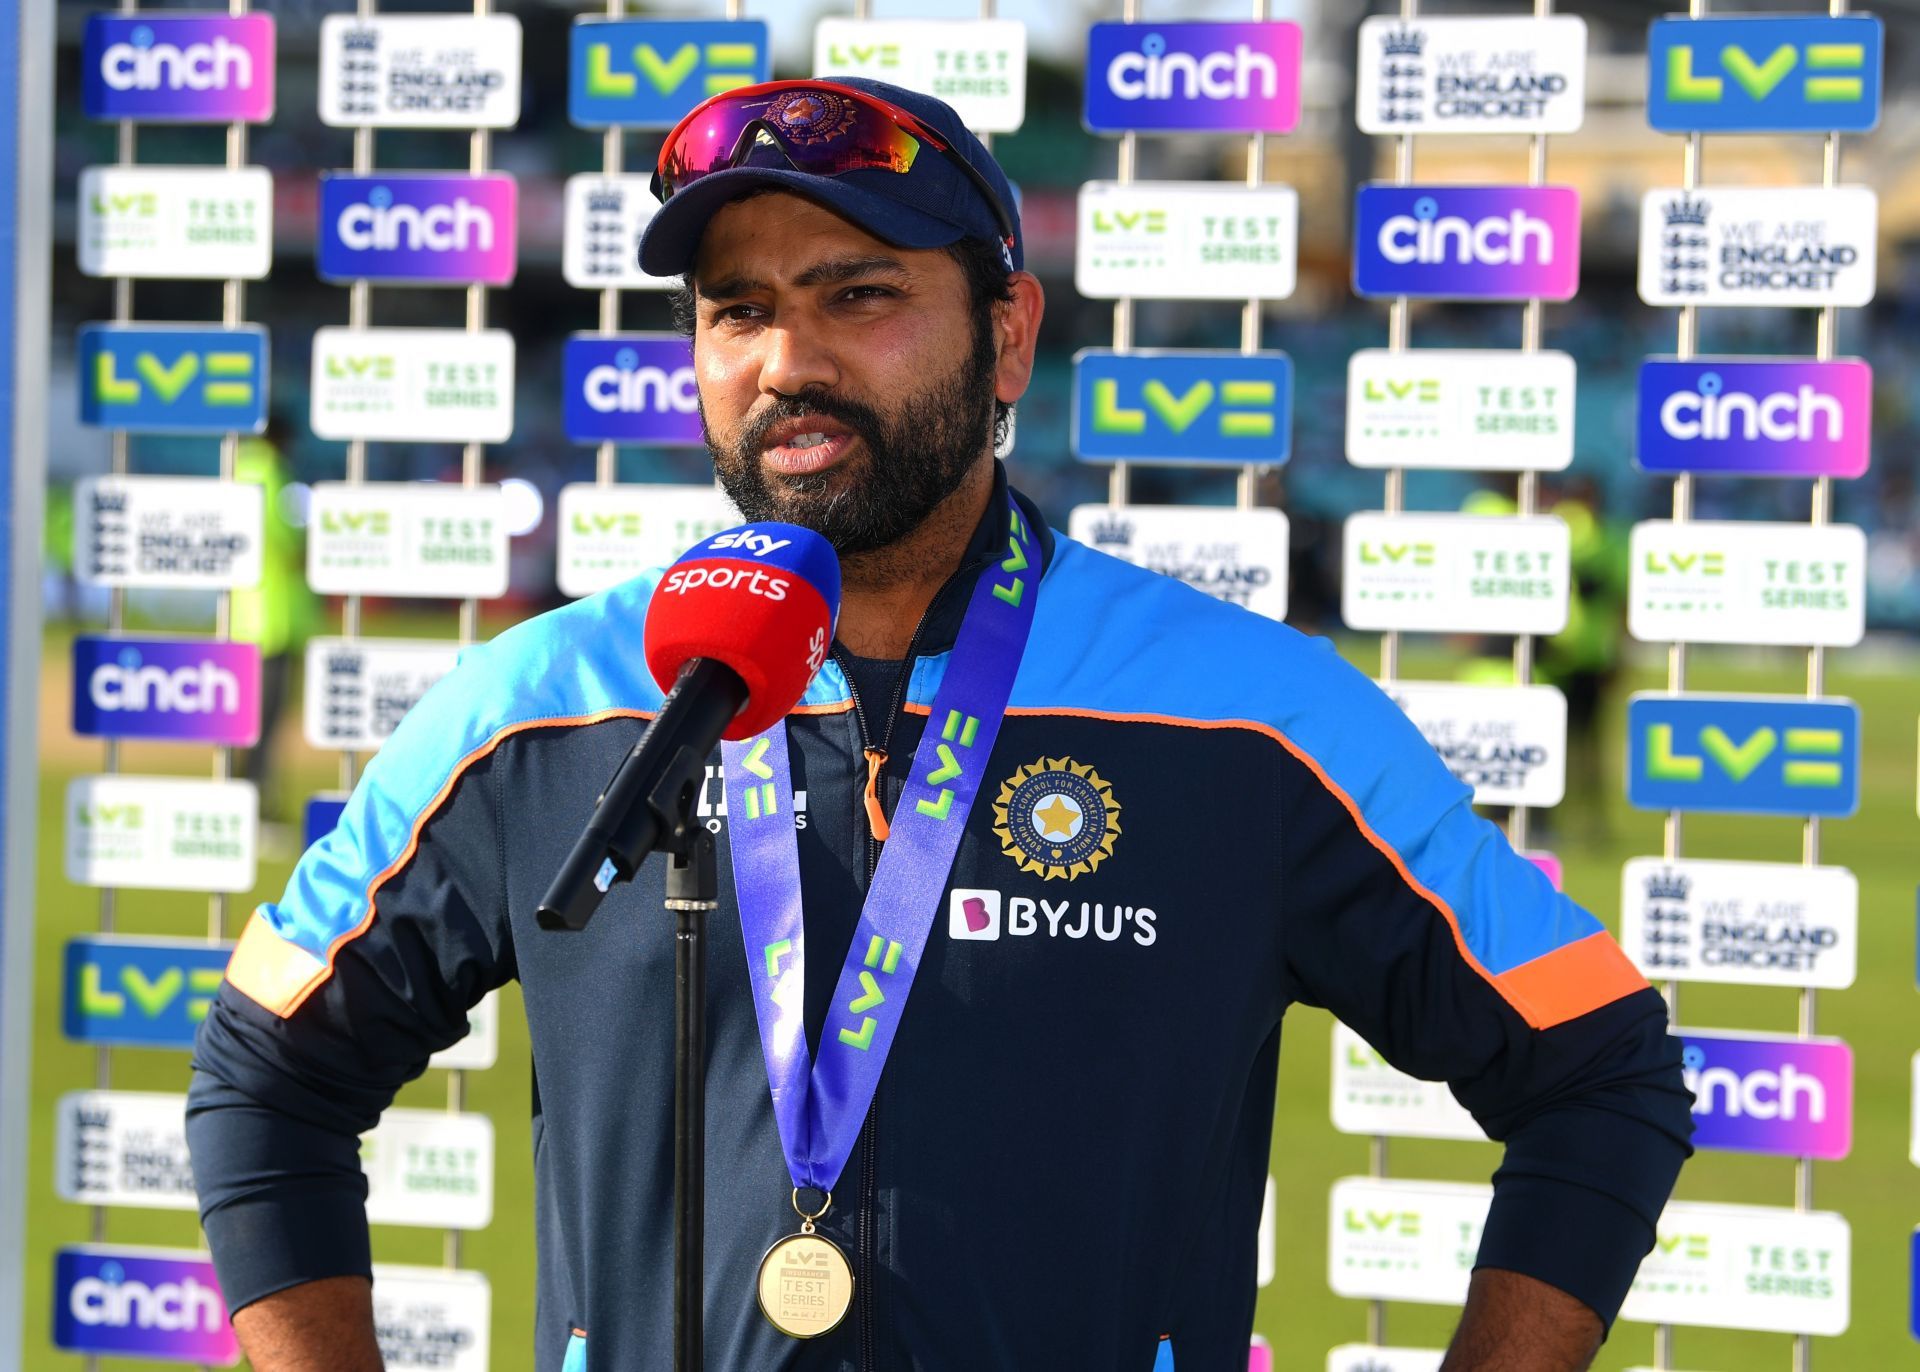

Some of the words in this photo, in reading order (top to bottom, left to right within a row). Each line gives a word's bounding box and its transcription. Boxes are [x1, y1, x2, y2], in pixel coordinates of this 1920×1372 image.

[100, 25, 253, 91] cinch
[935, 50, 1009, 71] TEST
[1107, 33, 1277, 100] cinch
[388, 70, 504, 91] ENGLAND
[933, 77, 1010, 96] SERIES
[1435, 75, 1566, 95] ENGLAND
[387, 91, 486, 112] CRICKET
[1434, 98, 1549, 118] CRICKET
[188, 199, 256, 220] TEST
[338, 185, 493, 251] cinch
[186, 225, 256, 246] SERIES
[1202, 217, 1281, 240] TEST
[1377, 197, 1553, 265] cinch
[1200, 243, 1281, 264] SERIES
[1720, 245, 1857, 267] ENGLAND
[1719, 269, 1838, 290] CRICKET
[427, 362, 498, 384] TEST
[583, 348, 697, 412] cinc
[425, 388, 498, 409] SERIES
[1480, 387, 1558, 409] TEST
[1661, 372, 1844, 442] cinch
[1475, 413, 1559, 434] SERIES
[423, 518, 494, 540] TEST
[138, 532, 249, 553] ENGLAND
[708, 530, 792, 557] sky
[138, 552, 231, 573] CRICKET
[420, 544, 495, 564] SERIES
[1473, 551, 1553, 573] TEST
[1764, 561, 1849, 584] TEST
[664, 568, 790, 601] sports
[1470, 577, 1553, 599] SERIES
[1761, 589, 1849, 610] SERIES
[91, 647, 238, 714] cinch
[1055, 779, 1073, 789] FOR
[1018, 781, 1051, 810] CONTROL
[1074, 786, 1098, 820] CRICKET
[174, 811, 243, 833] TEST
[1017, 811, 1024, 822] OF
[1018, 826, 1042, 852] BOARD
[1090, 823, 1098, 833] IN
[172, 838, 243, 860] SERIES
[1072, 834, 1094, 854] INDIA
[1009, 897, 1157, 946] BYJU'S
[1702, 923, 1837, 948] ENGLAND
[1701, 947, 1819, 970] CRICKET
[1684, 1046, 1826, 1122] inch
[408, 1144, 477, 1168] TEST
[405, 1173, 478, 1194] SERIES
[1656, 1234, 1709, 1259] V=
[1748, 1245, 1830, 1270] TEST
[70, 1261, 221, 1333] cinch
[784, 1280, 825, 1292] TEST
[1746, 1274, 1833, 1298] SERIES
[783, 1294, 825, 1306] SERIES
